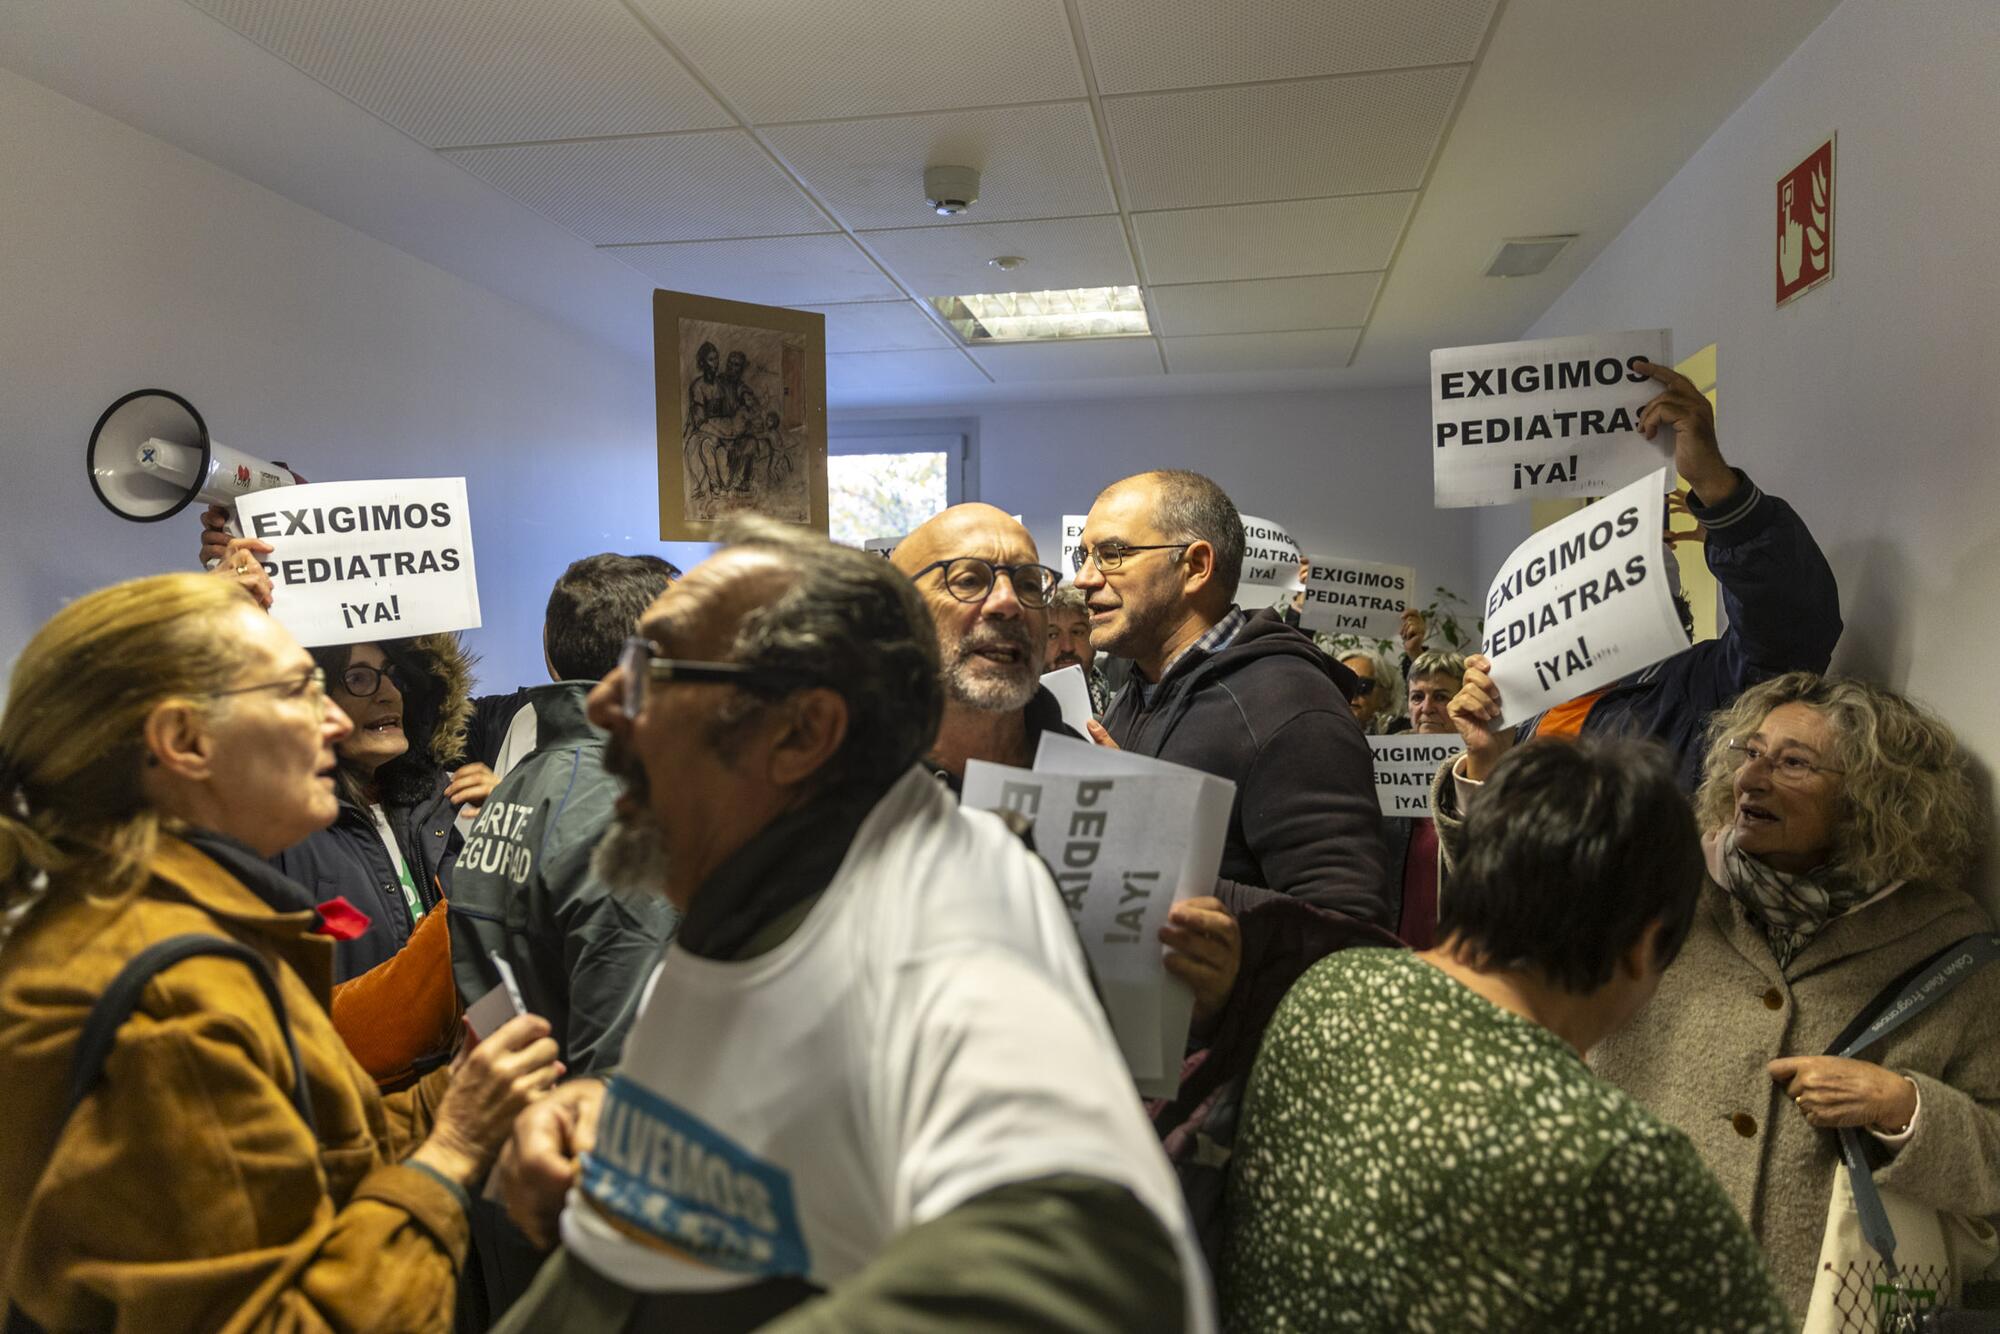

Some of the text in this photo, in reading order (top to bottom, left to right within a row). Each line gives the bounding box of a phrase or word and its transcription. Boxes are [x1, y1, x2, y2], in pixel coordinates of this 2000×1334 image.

[1440, 355, 1651, 400] EXIGIMOS
[1513, 455, 1578, 490] ¡YA!
[251, 502, 451, 538] EXIGIMOS
[1487, 506, 1640, 620] EXIGIMOS
[1311, 566, 1405, 590] EXIGIMOS
[341, 595, 401, 628] ¡YA!
[1305, 589, 1406, 613] PEDIATRAS
[1336, 614, 1368, 629] ¡YA!
[1534, 636, 1594, 692] ¡YA!
[1372, 746, 1460, 762] XIGIMOS
[1396, 795, 1428, 809] ¡YA!
[1944, 953, 1974, 976] Calvin
